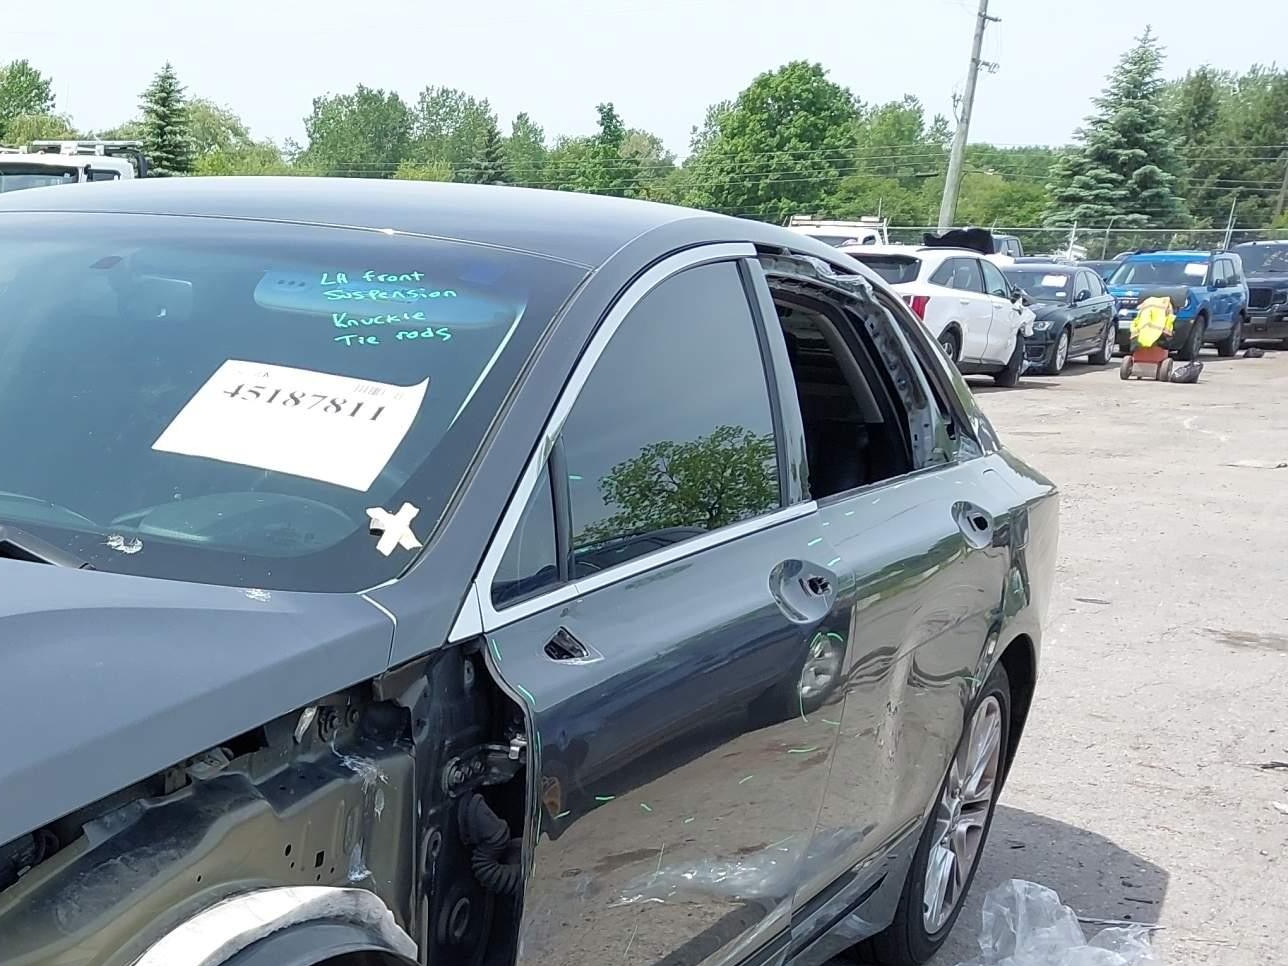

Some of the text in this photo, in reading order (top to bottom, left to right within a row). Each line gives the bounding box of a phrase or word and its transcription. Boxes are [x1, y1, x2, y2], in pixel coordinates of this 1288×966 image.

[362, 270, 425, 282] front
[322, 288, 457, 300] Suspension
[332, 312, 426, 328] Knuckle
[334, 327, 452, 346] Tie rods
[223, 383, 386, 421] 45187811
